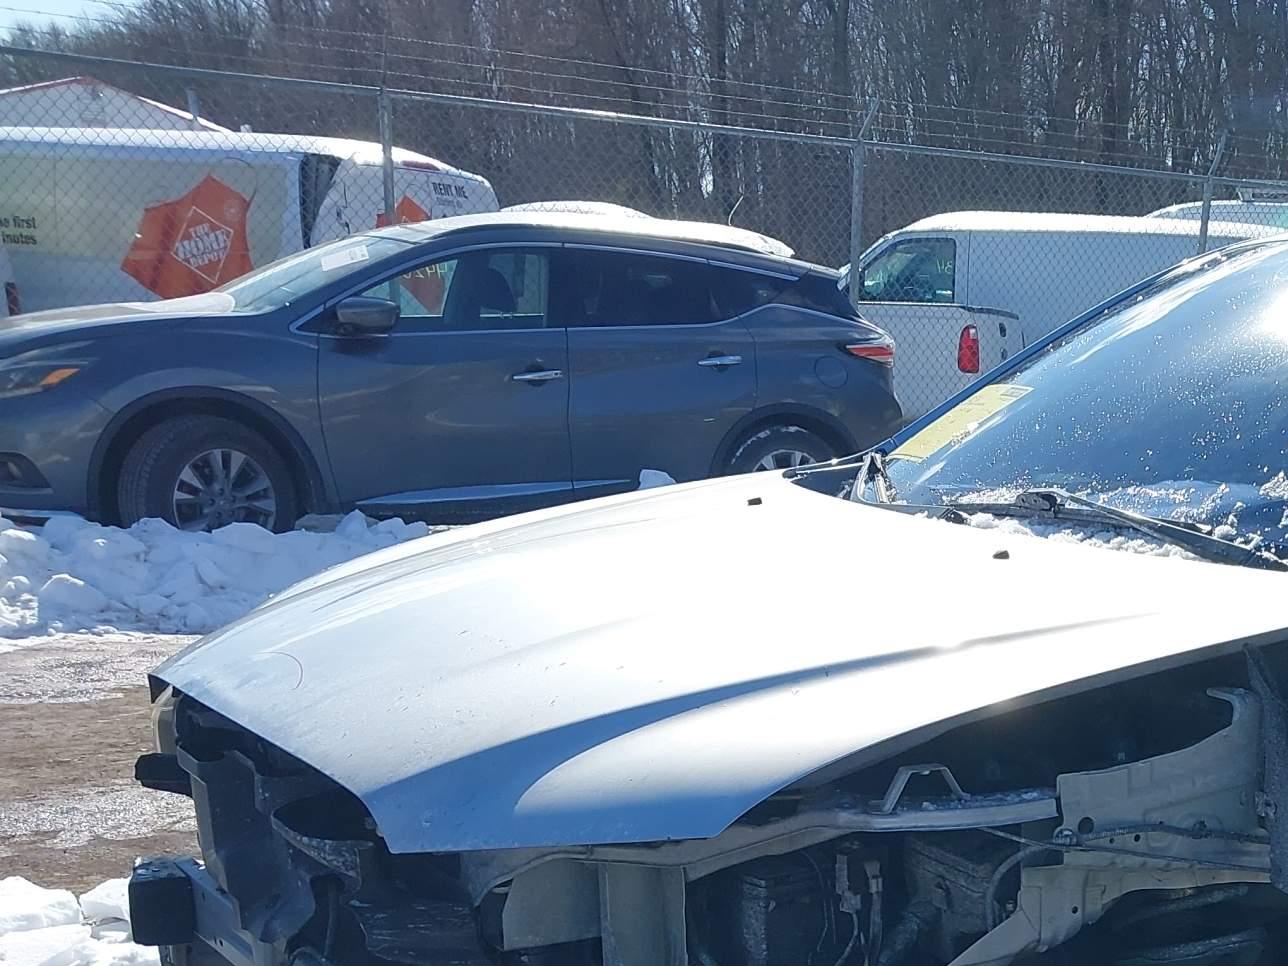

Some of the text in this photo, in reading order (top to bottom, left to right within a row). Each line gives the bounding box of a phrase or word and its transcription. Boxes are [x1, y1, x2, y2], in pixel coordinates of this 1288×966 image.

[432, 182, 468, 199] RENT ME
[13, 216, 37, 229] first
[188, 223, 210, 238] THE
[176, 229, 228, 258] HOME
[187, 250, 226, 267] DEPOT
